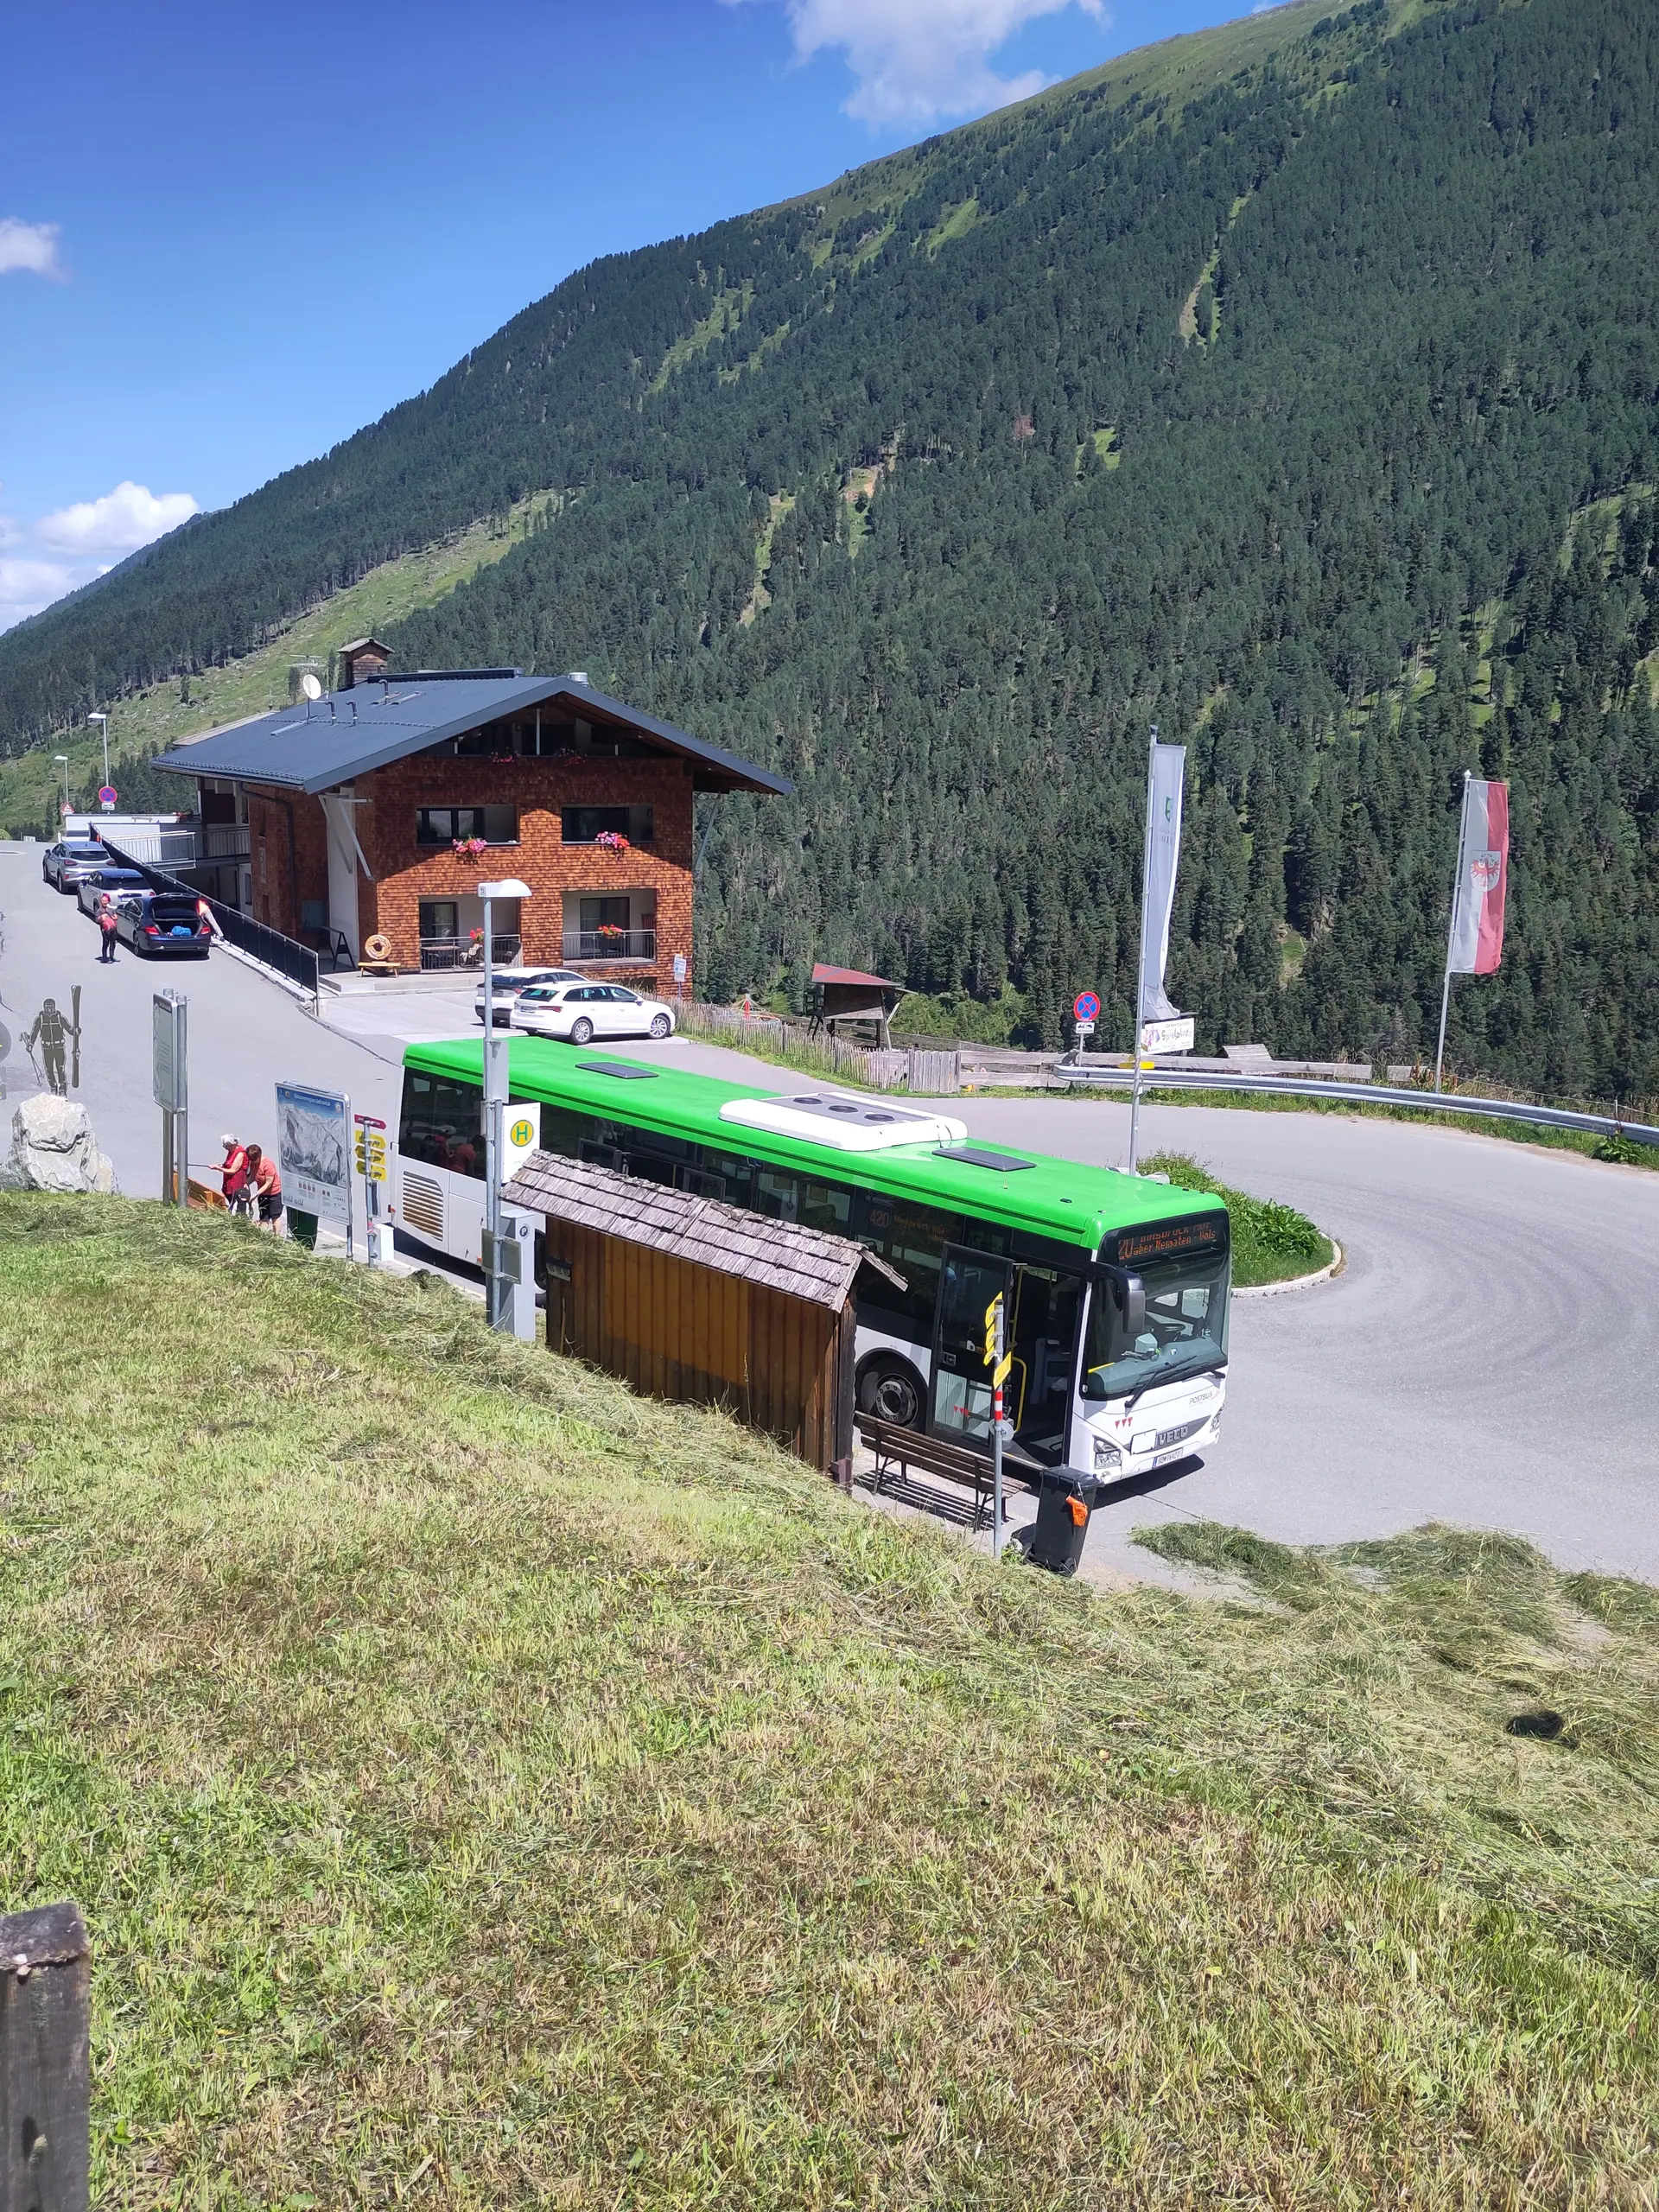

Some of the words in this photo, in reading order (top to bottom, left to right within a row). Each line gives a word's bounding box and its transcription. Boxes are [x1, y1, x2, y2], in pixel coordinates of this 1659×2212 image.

[516, 1124, 528, 1142] H
[869, 1210, 889, 1227] 420
[1189, 1391, 1212, 1404] POSTBUS
